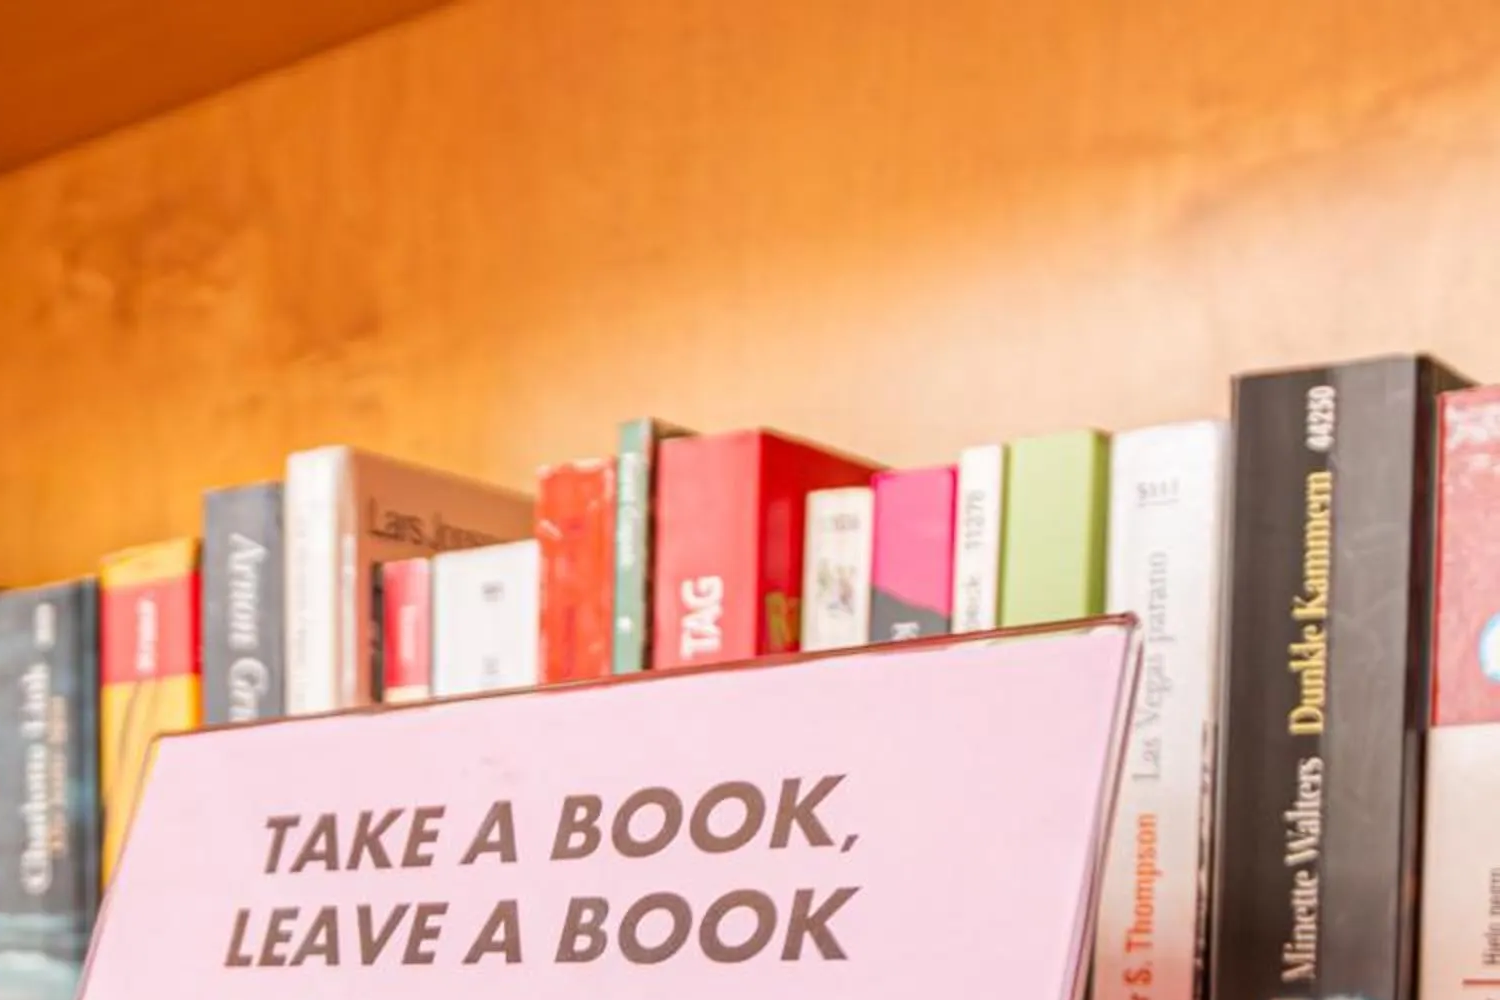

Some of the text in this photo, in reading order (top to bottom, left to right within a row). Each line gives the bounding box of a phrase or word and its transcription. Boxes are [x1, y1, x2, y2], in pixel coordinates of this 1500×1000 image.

[229, 532, 268, 651] Arnon
[1292, 470, 1333, 621] Kammern
[680, 574, 723, 659] TAG
[1135, 652, 1172, 728] Vegas
[1288, 622, 1328, 737] Dunkle
[1131, 738, 1163, 783] Las
[1283, 756, 1324, 867] Walters
[264, 773, 861, 875] TAKE A BOOK,
[223, 885, 861, 969] LEAVE A BOOK
[1125, 813, 1165, 953] Thompson
[1281, 870, 1320, 981] Minette
[1123, 960, 1153, 986] S.
